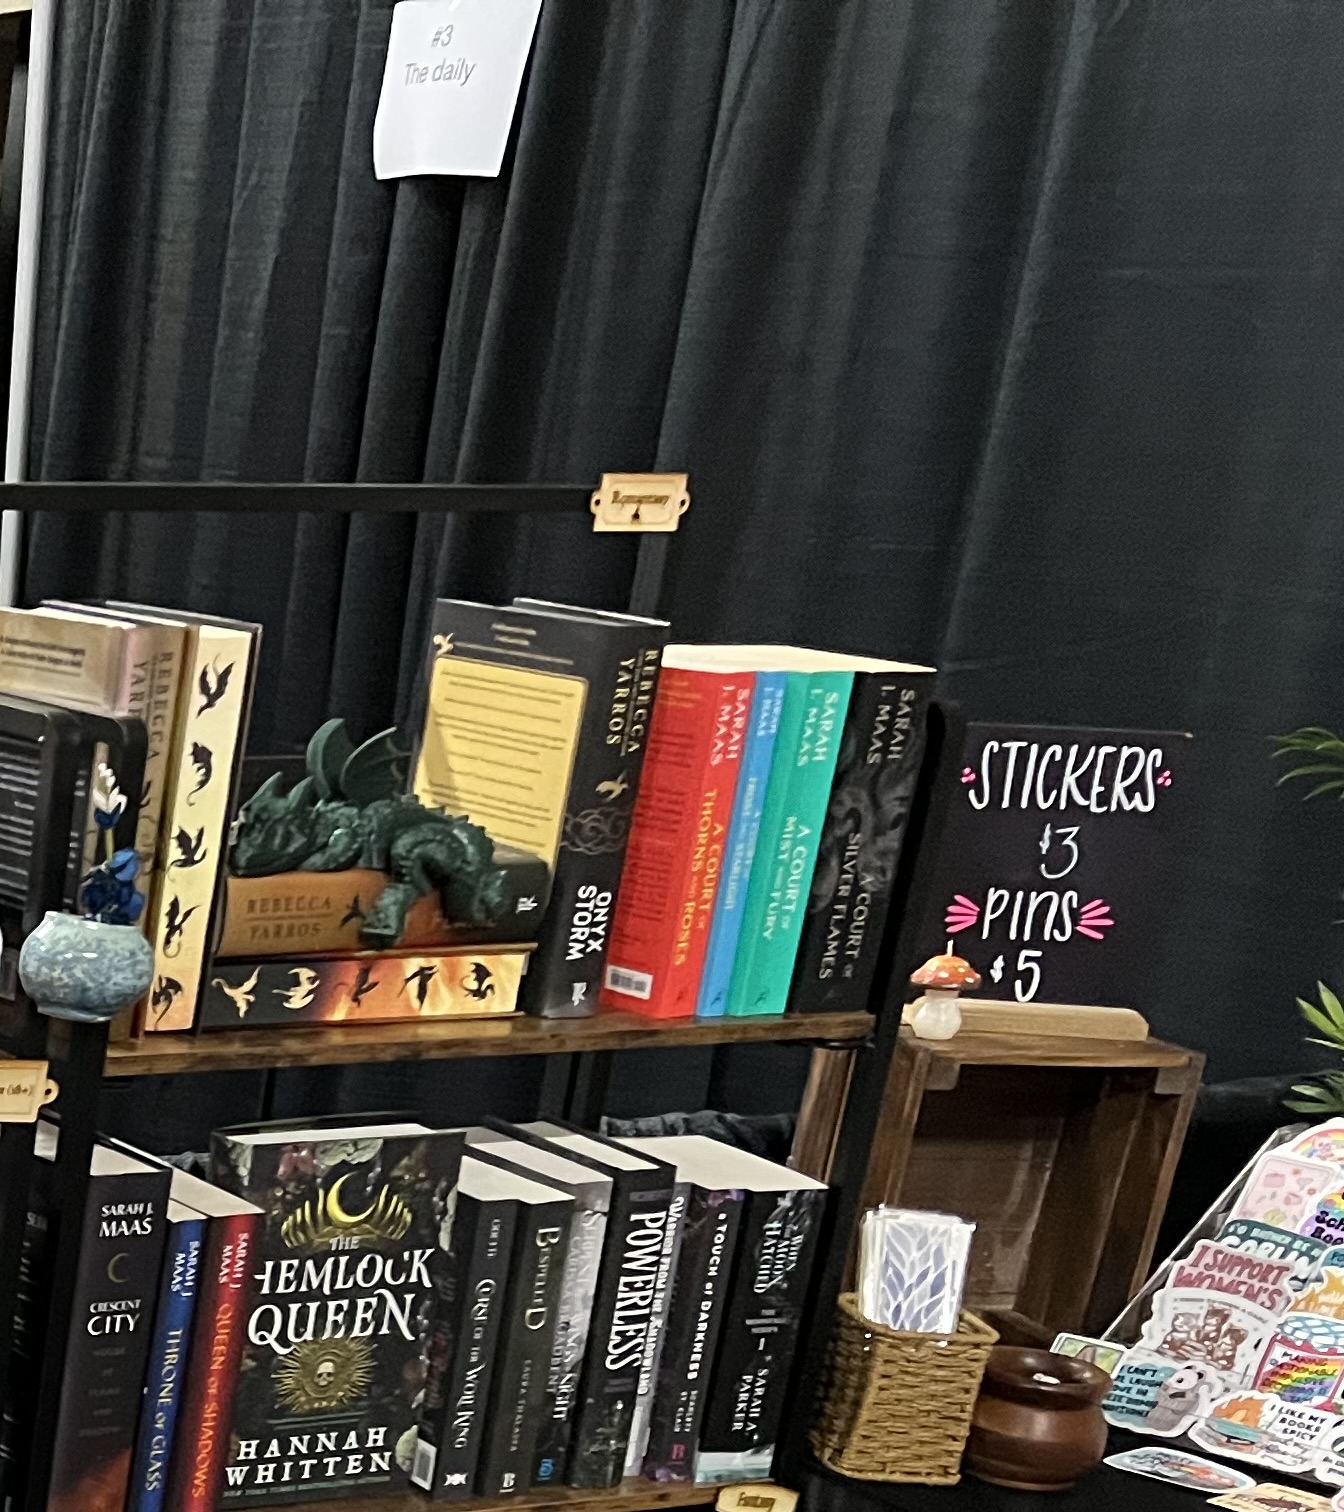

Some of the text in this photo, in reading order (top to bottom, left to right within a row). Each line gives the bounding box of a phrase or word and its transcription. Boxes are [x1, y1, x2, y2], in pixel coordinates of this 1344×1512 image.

[431, 24, 454, 48] #3
[405, 57, 477, 86] The daily
[968, 740, 1162, 813] STICKERS
[566, 885, 598, 961] STORM
[585, 892, 613, 953] ONYX
[99, 1217, 153, 1238] MAAS
[254, 1248, 436, 1295] HEMLOCK
[1173, 1266, 1284, 1310] WOMEN'S
[1205, 1251, 1291, 1286] SUPPORT
[605, 1211, 667, 1370] POWERLESS
[87, 1314, 141, 1335] CITY
[247, 1289, 416, 1354] QUEEN
[237, 1427, 388, 1460] HANNAH
[225, 1452, 392, 1487] WHITTEN
